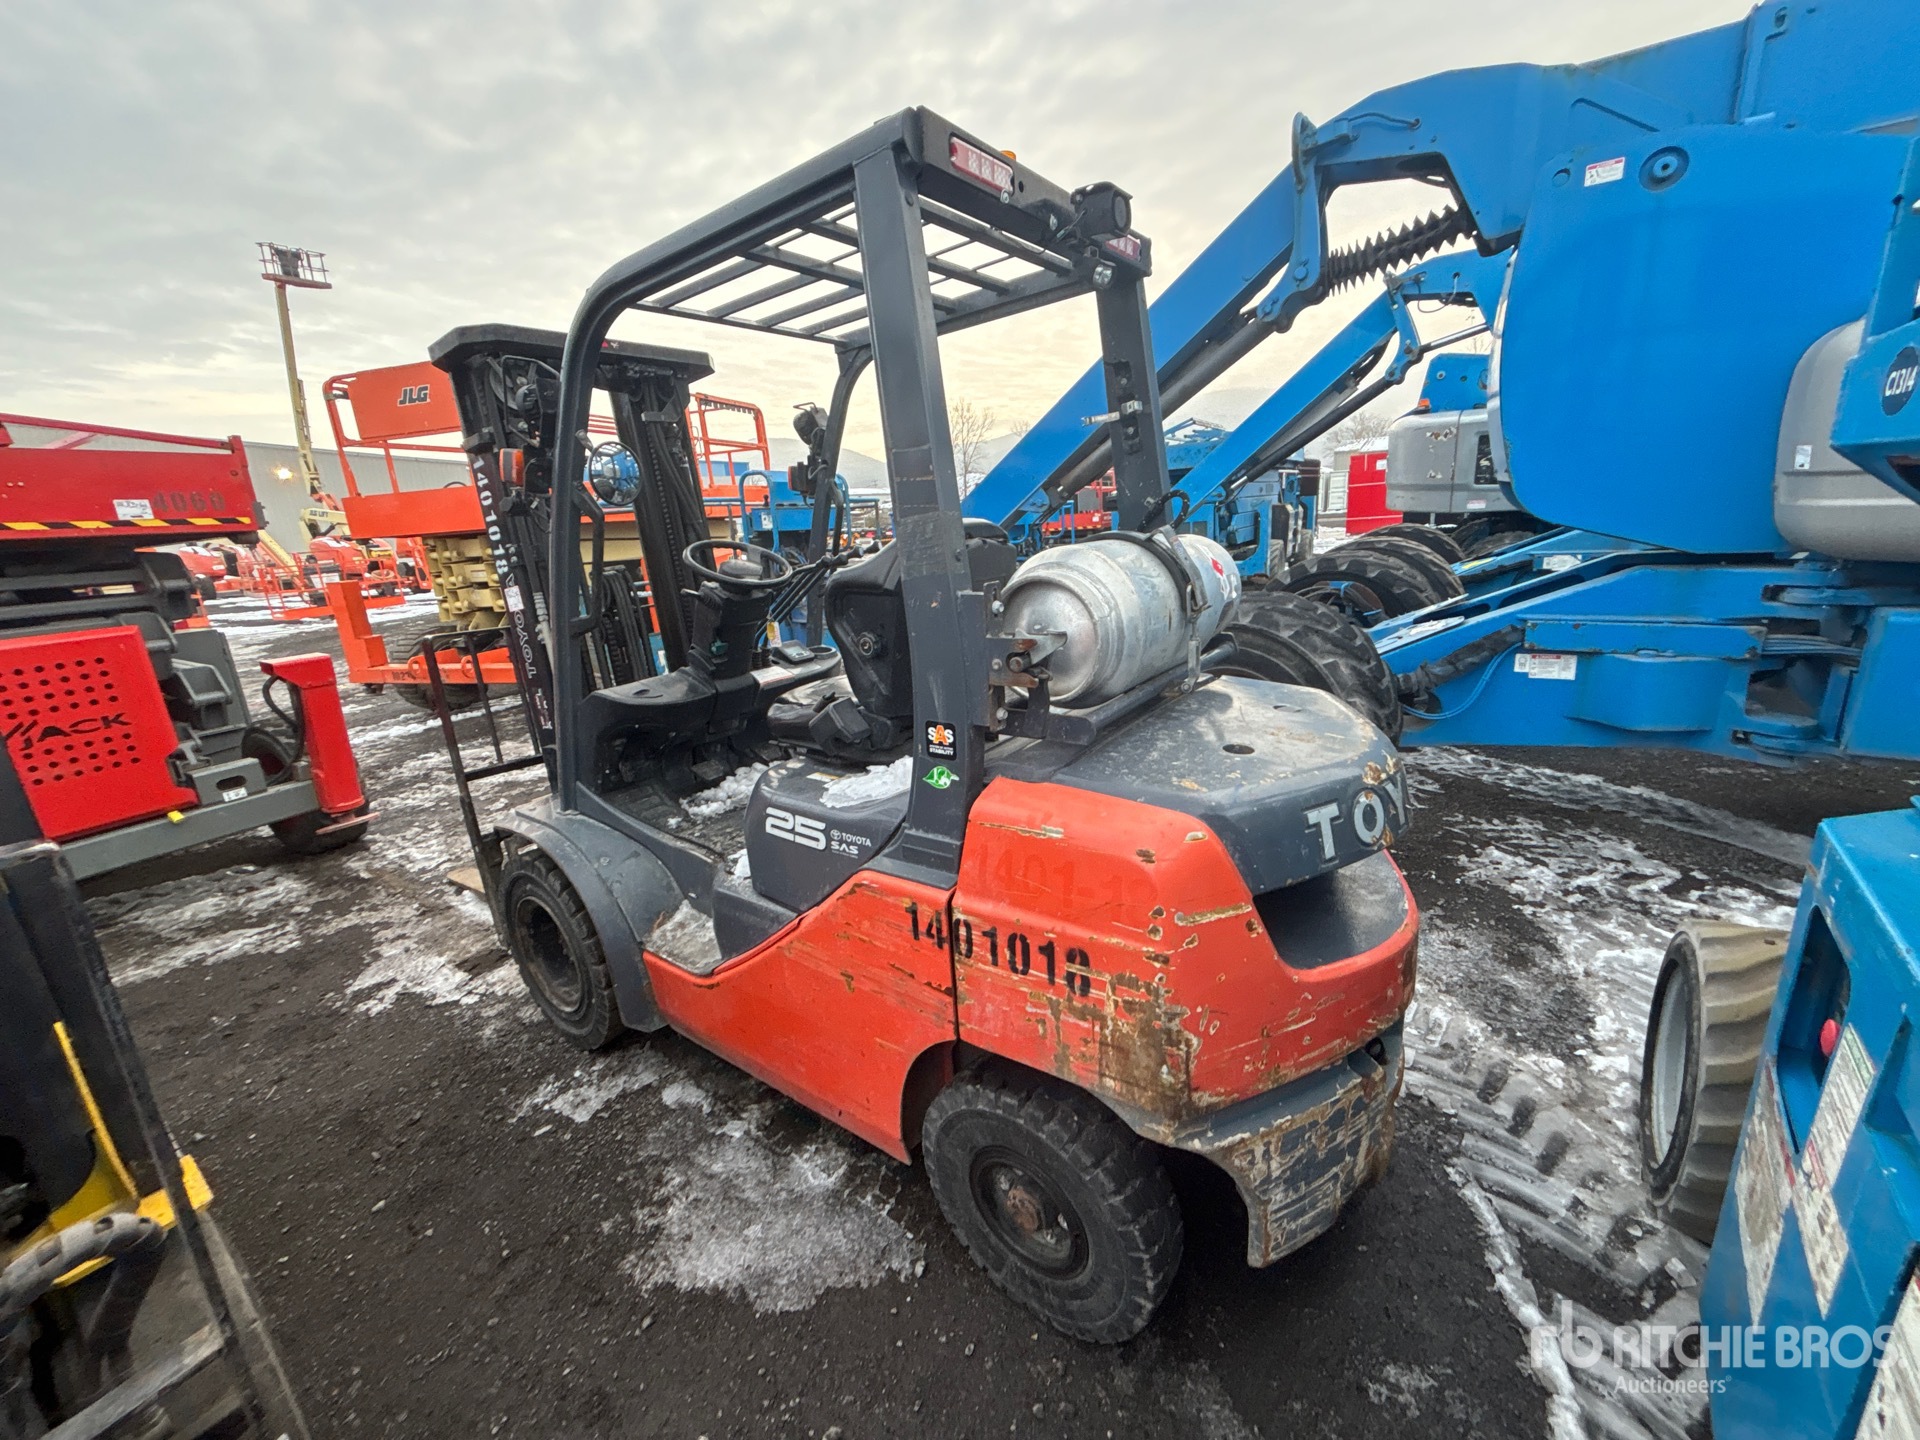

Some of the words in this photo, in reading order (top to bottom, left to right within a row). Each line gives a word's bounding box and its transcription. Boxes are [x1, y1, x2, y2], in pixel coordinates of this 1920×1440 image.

[397, 384, 430, 407] JLG
[473, 457, 509, 575] 1401018
[505, 572, 537, 679] TOYOA
[927, 724, 954, 746] SAS
[765, 806, 826, 851] 25
[842, 832, 872, 847] TOYOTA
[830, 840, 859, 855] SAS
[905, 902, 1091, 997] 1401018
